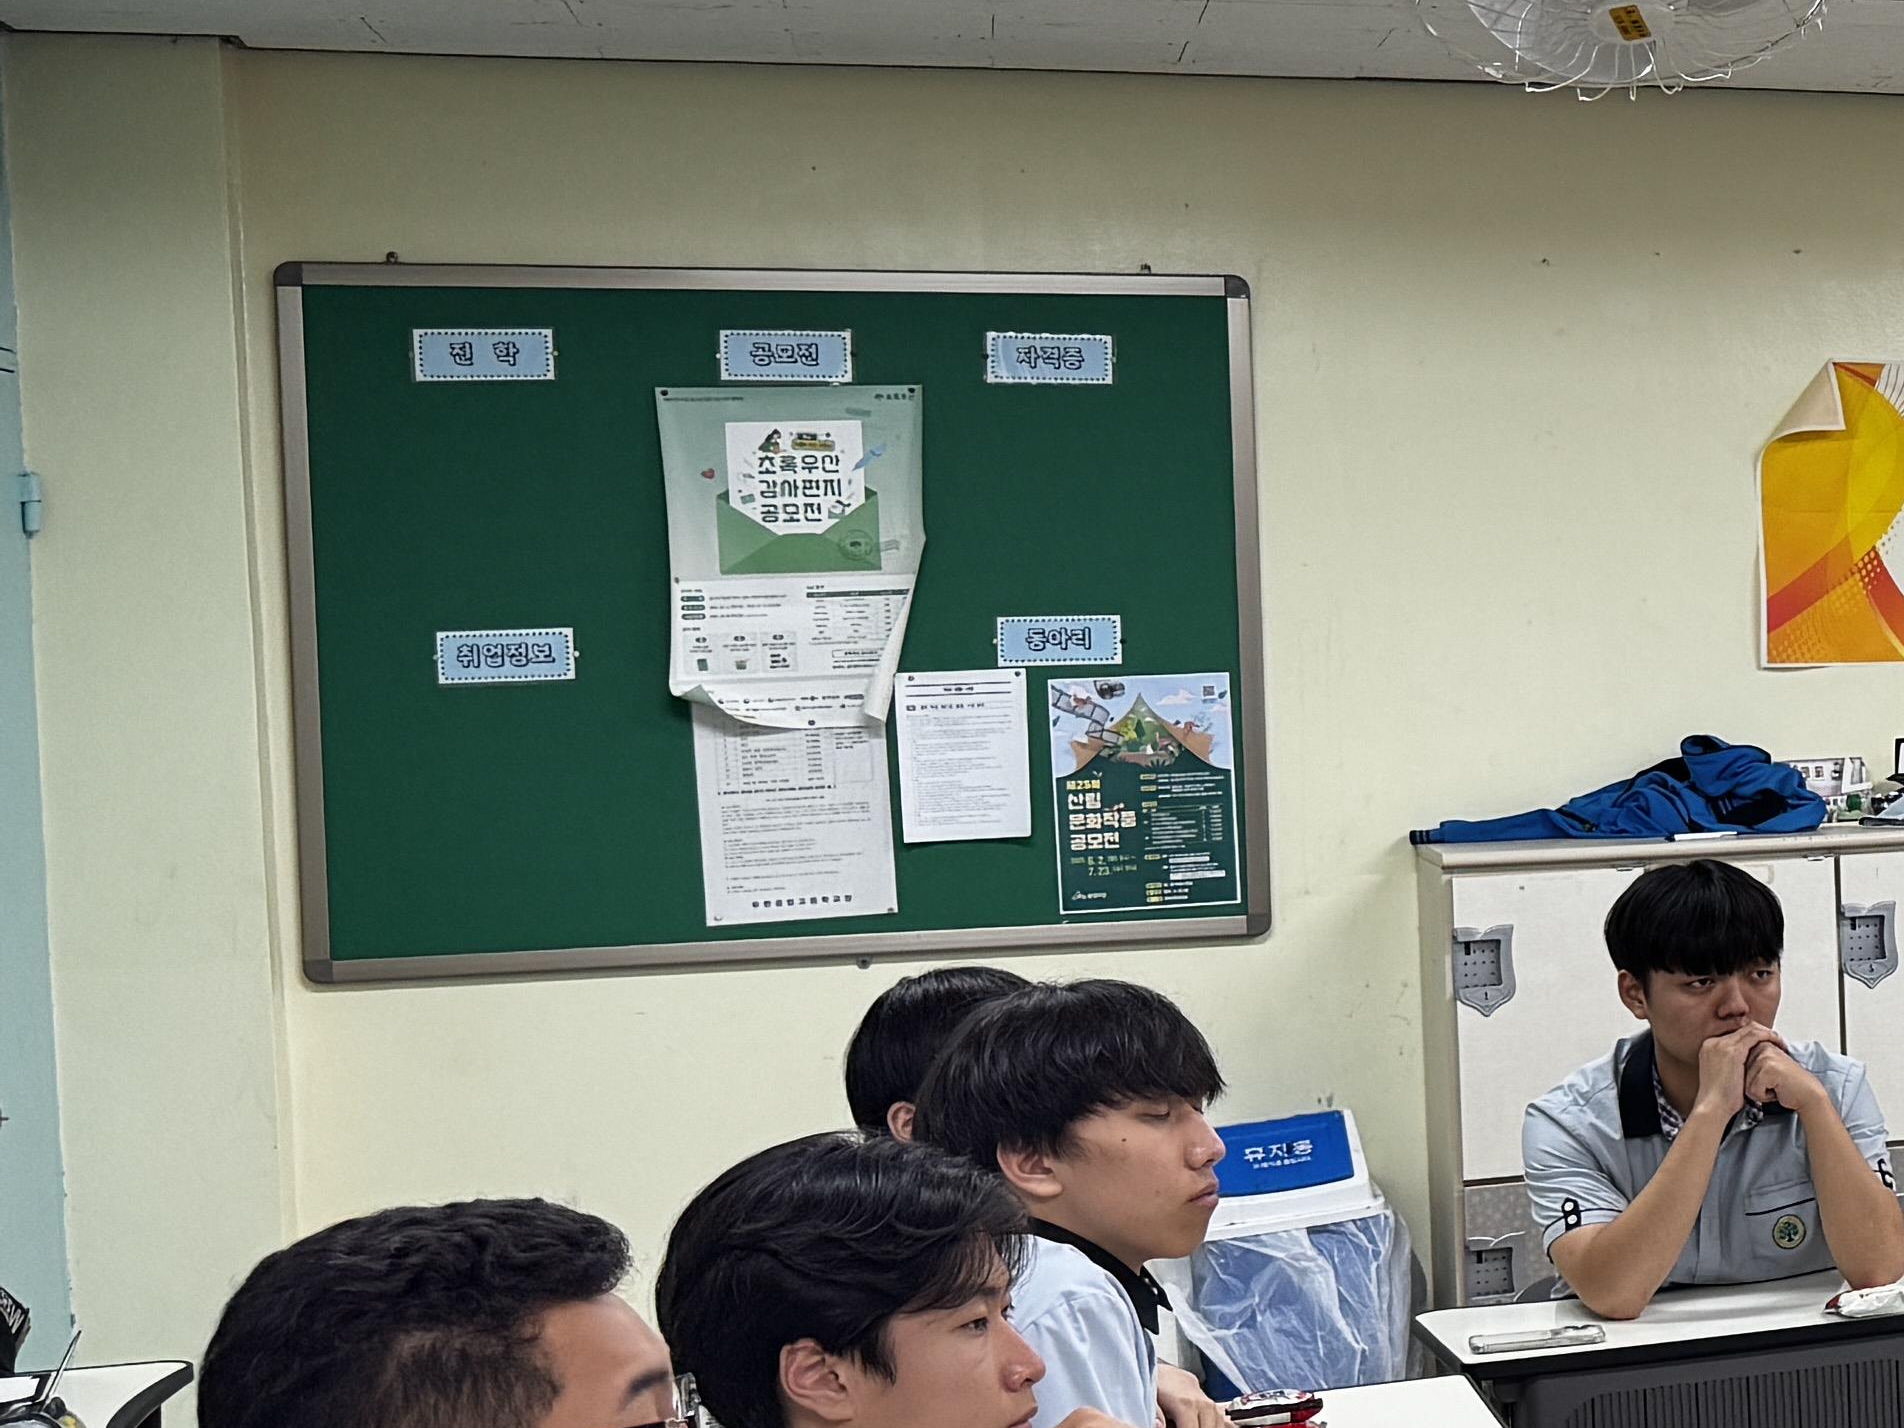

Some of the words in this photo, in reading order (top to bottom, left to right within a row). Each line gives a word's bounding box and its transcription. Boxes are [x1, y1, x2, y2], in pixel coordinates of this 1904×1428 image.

[750, 341, 820, 367] 공모전
[1016, 345, 1085, 370] 자격증
[758, 454, 840, 474] 초록우산
[759, 478, 841, 498] 감사편지
[760, 503, 822, 523] 공모전
[1025, 626, 1091, 651] 동아리
[457, 642, 556, 668] 취업정보
[1070, 832, 1120, 851] 공모전
